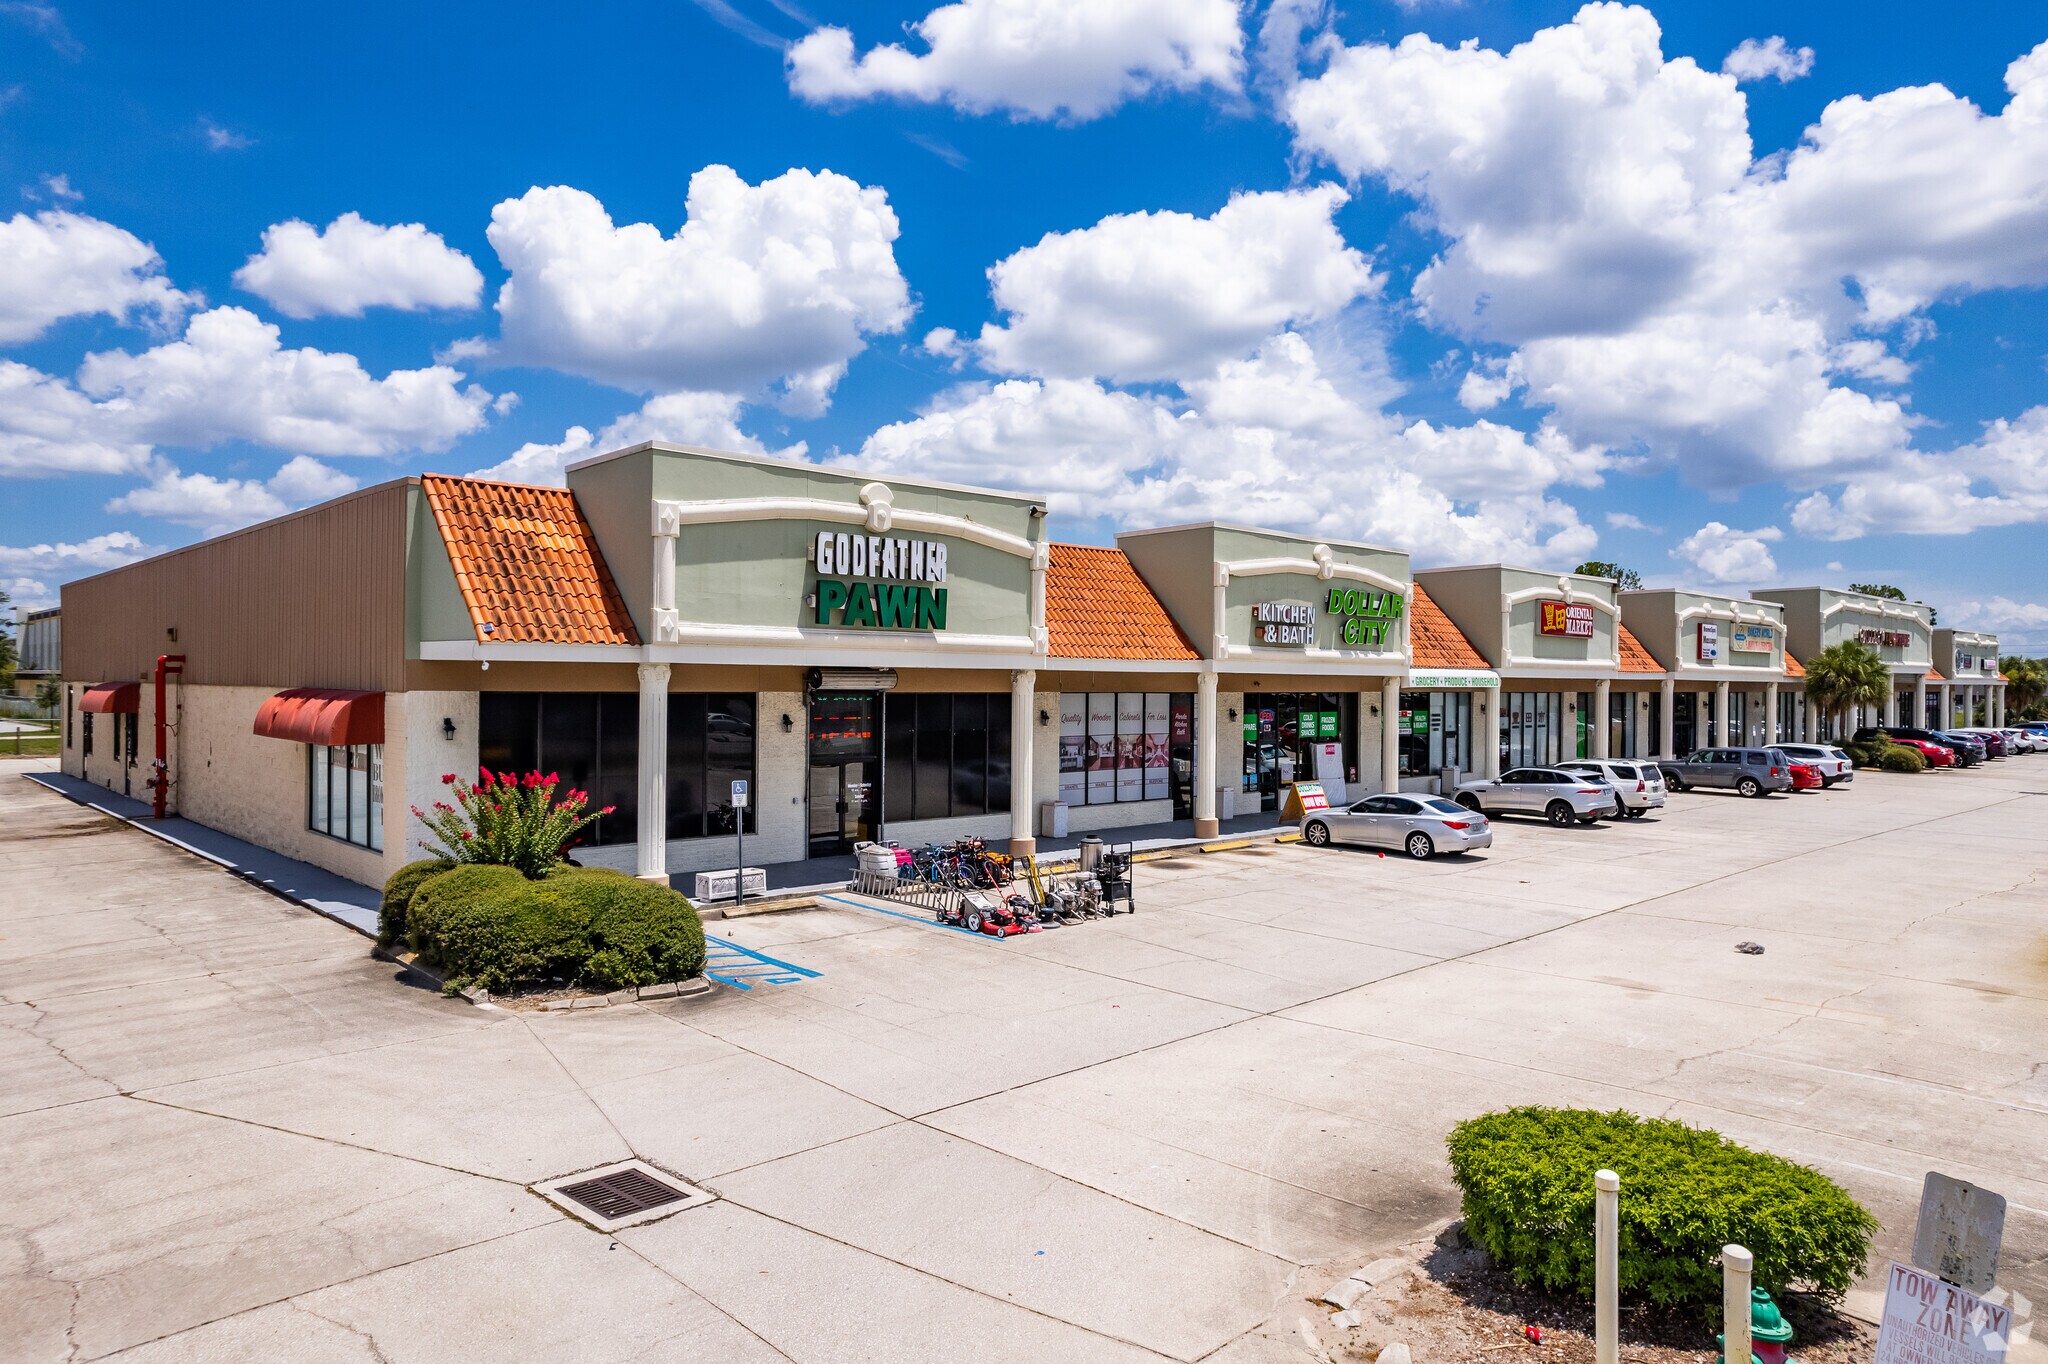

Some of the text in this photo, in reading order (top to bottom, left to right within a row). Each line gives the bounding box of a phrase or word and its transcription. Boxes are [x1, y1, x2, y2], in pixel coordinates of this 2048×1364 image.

[816, 531, 947, 582] GODFATHER
[815, 579, 947, 630] PAWN
[1258, 602, 1316, 625] KITCHEN
[1326, 588, 1404, 619] DOLLAR
[1566, 606, 1593, 620] ORIENTAL
[1264, 624, 1314, 645] & BATH
[1342, 617, 1391, 645] CITY
[1565, 619, 1593, 635] MARKET
[1415, 676, 1499, 687] GROCERY PRODUCE HOUSEHOLD
[1060, 713, 1082, 726] Quality
[1895, 1267, 2006, 1332] TOW AWAY
[1916, 1301, 1971, 1346] ZONE
[1886, 1341, 1898, 1354] AT
[1887, 1313, 1945, 1348] UNAUTHORIZED
[1947, 1340, 1985, 1364] VEHICLES
[1888, 1327, 1925, 1353] VESSELS
[1926, 1343, 1946, 1363] WILL
[1880, 1351, 1891, 1364] 24
